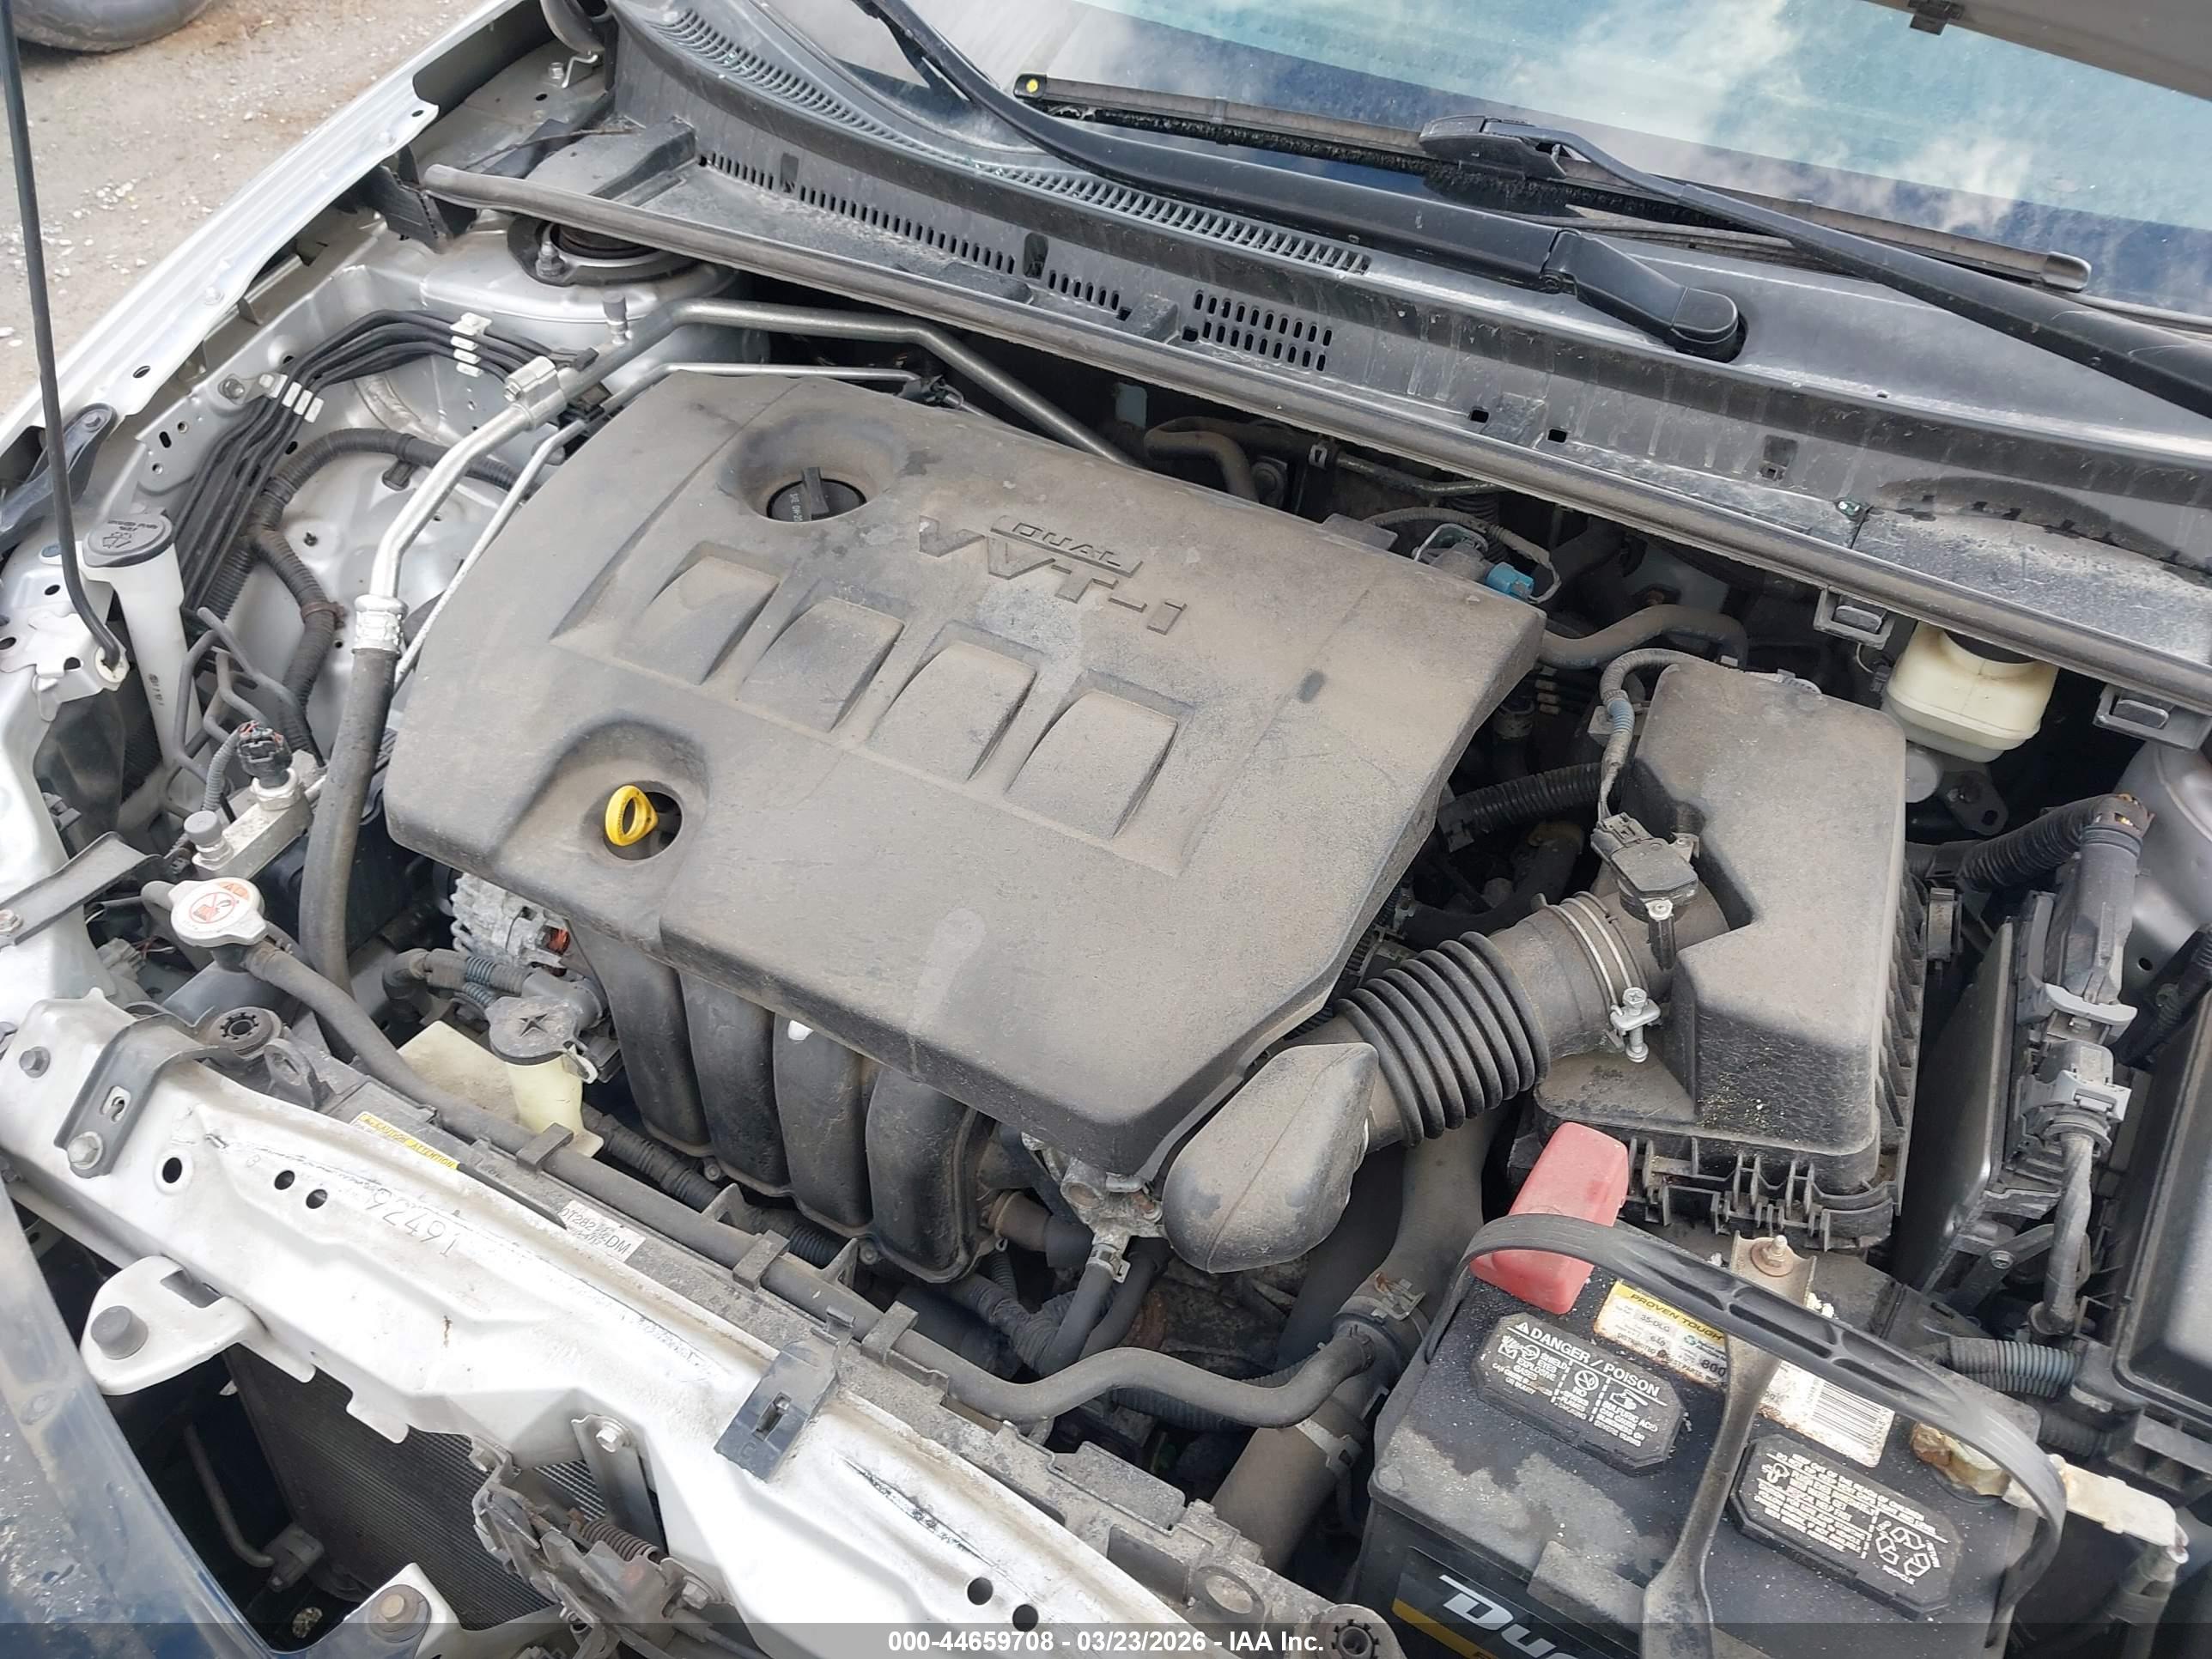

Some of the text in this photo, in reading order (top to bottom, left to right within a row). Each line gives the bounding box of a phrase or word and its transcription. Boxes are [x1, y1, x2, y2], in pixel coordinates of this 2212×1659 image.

[1012, 521, 1121, 568] DUAL
[604, 1235, 632, 1255] DM
[1630, 1293, 1679, 1320] PROVEN
[1682, 1318, 1725, 1340] TOUGH
[1516, 1356, 1557, 1382] EXPLOSIVE
[1530, 1327, 1590, 1366] DANGER
[1603, 1364, 1660, 1398] POISON
[1536, 1358, 1558, 1374] EYES
[1540, 1352, 1568, 1370] SHIELD
[1700, 1359, 1727, 1376] 800
[1571, 1385, 1588, 1398] NO
[1601, 1400, 1659, 1433] SULFURIC ACID
